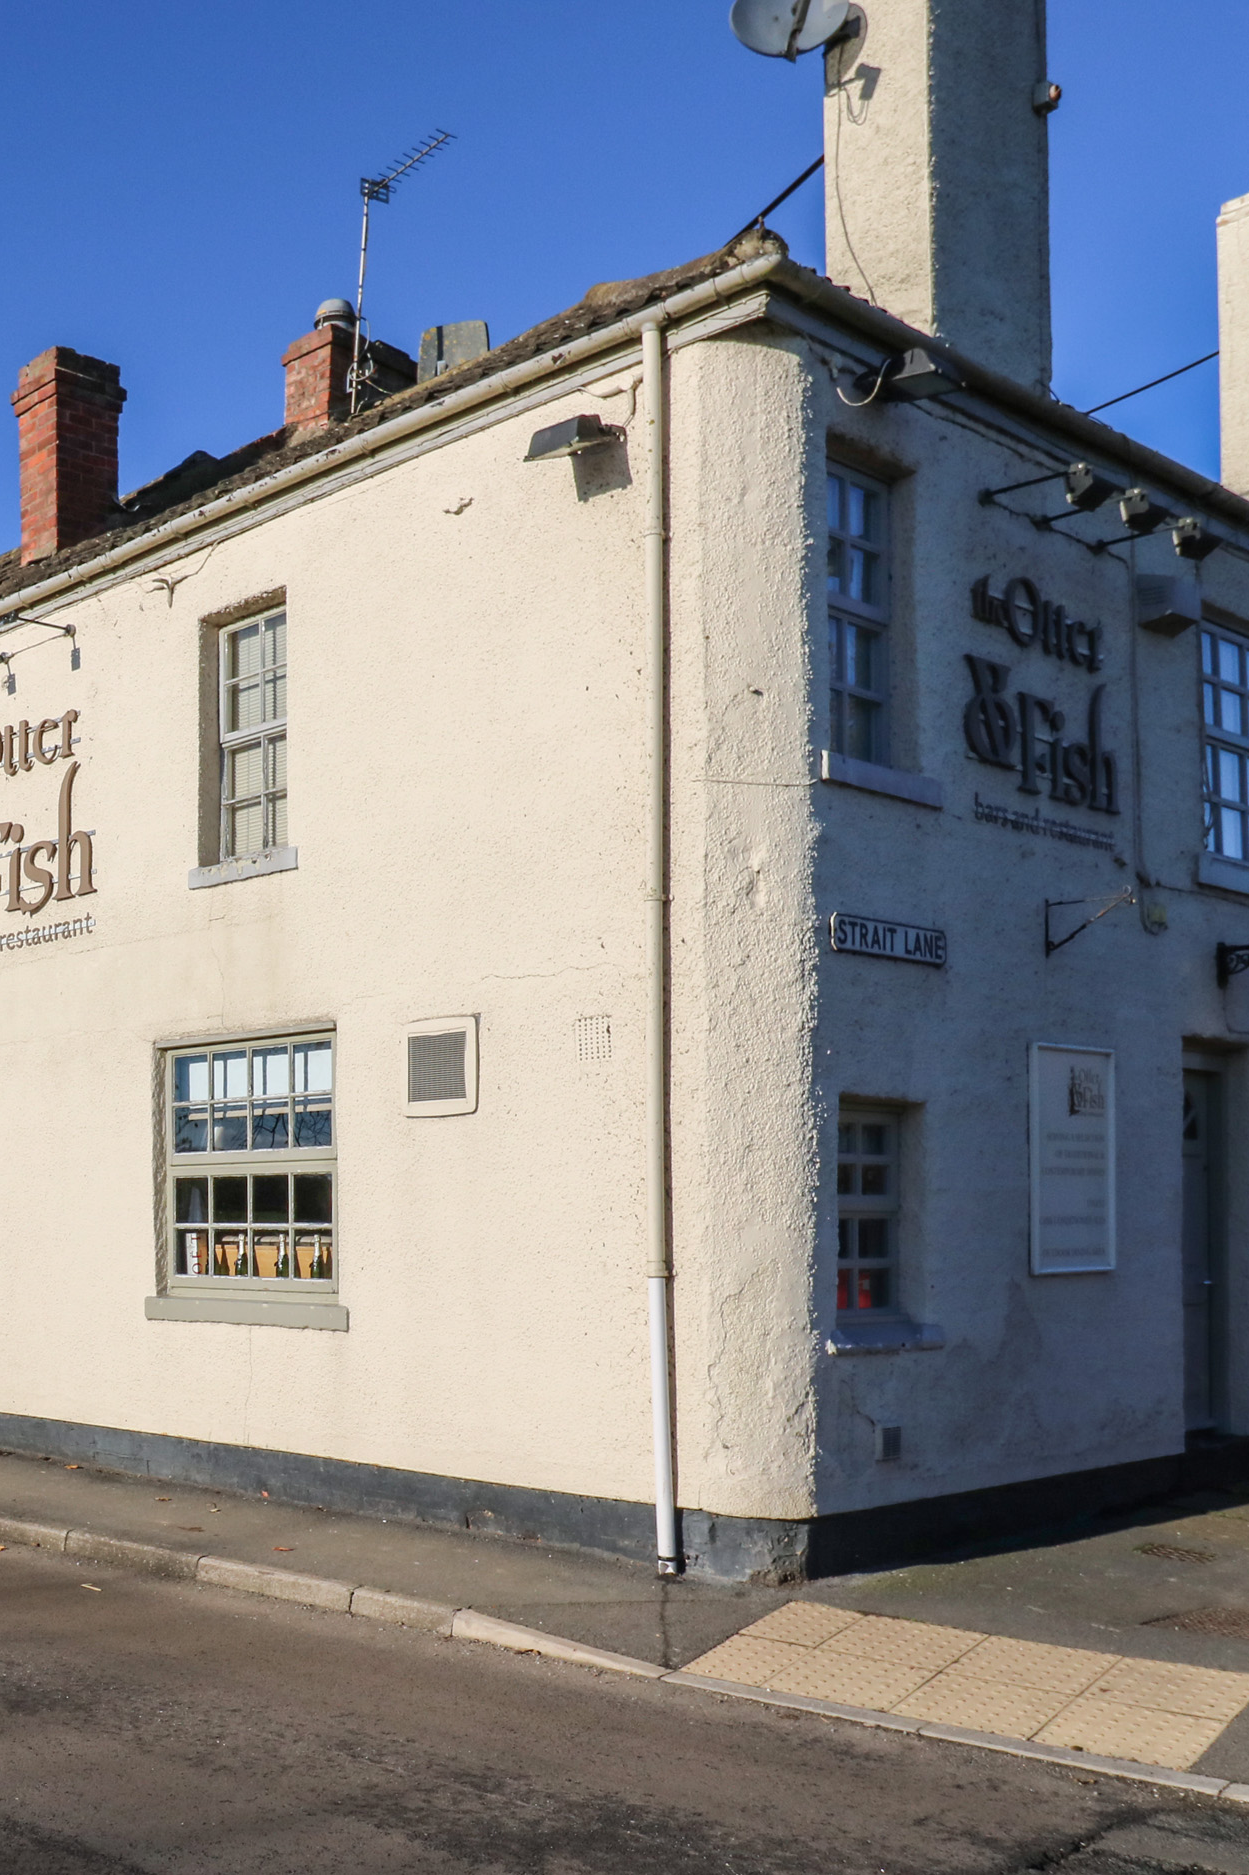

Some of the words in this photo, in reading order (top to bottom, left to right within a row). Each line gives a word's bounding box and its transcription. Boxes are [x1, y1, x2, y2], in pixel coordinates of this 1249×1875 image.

[1016, 684, 1119, 813] Fish
[0, 912, 92, 951] restaurant
[838, 919, 897, 952] STRAIT
[904, 930, 944, 960] LANE
